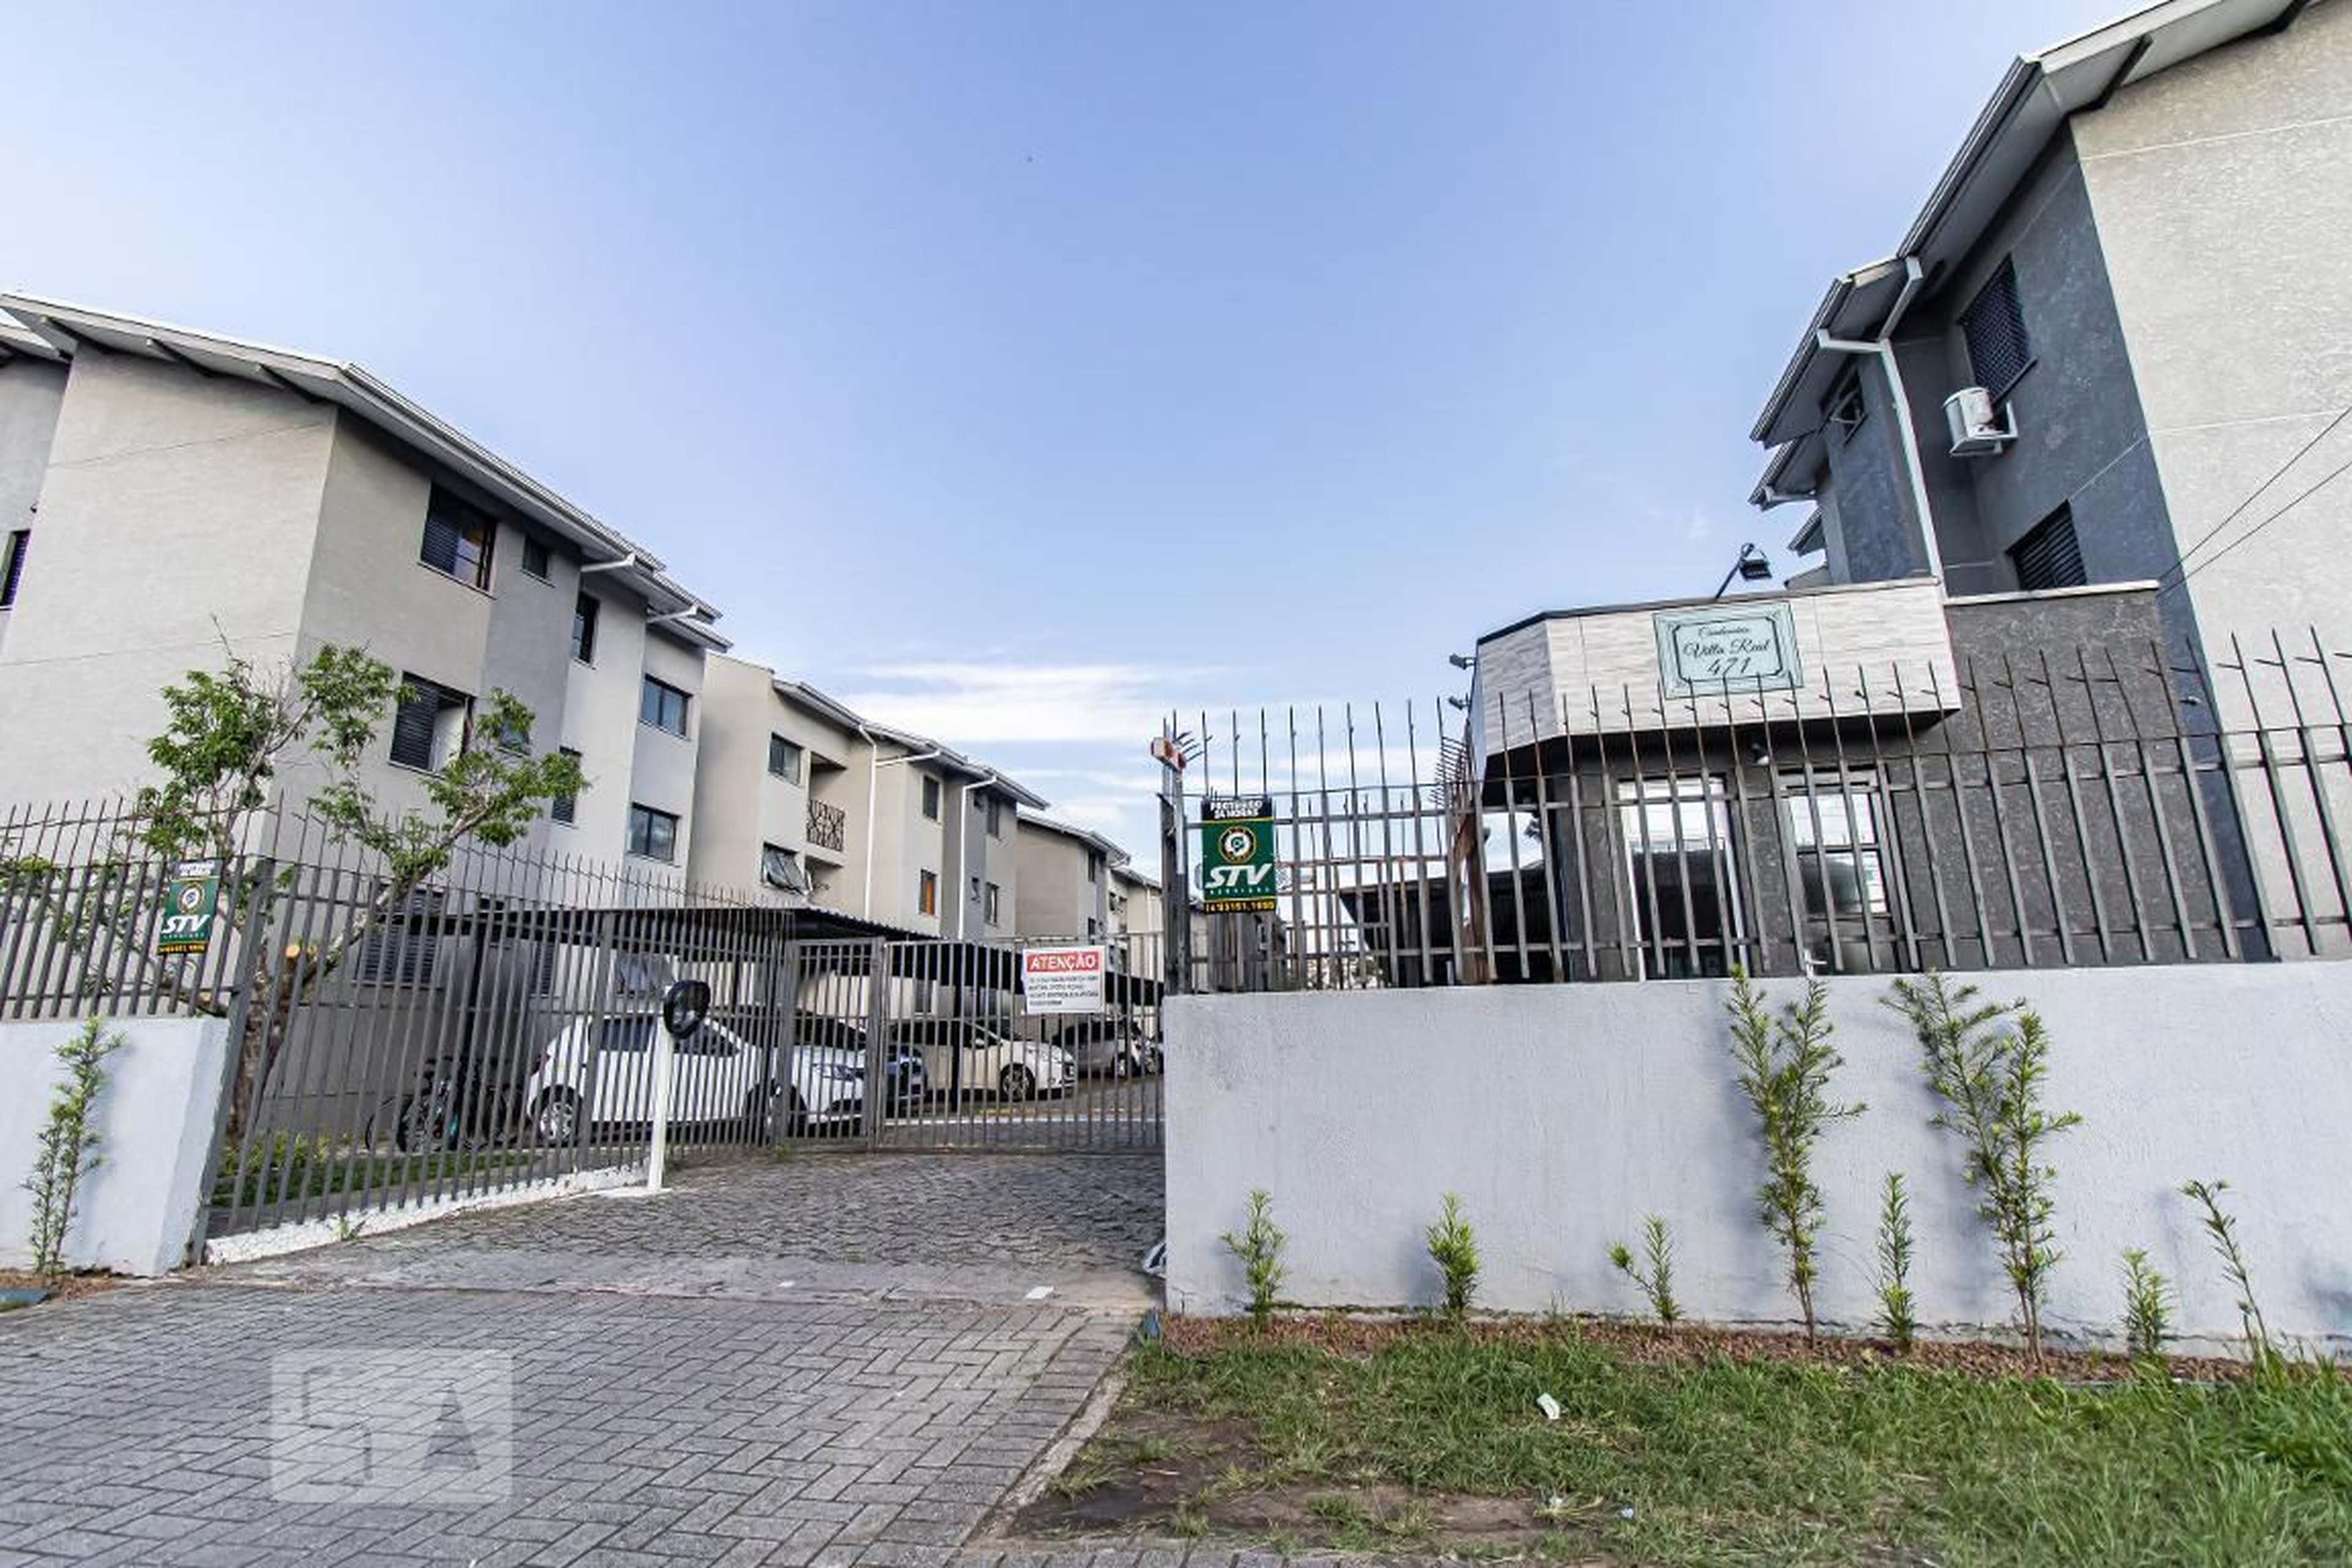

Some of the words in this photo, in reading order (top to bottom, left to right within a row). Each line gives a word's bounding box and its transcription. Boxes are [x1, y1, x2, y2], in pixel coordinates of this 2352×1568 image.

[1683, 642, 1725, 658] Villa
[1729, 638, 1771, 654] Real
[1706, 657, 1752, 676] 471
[1205, 862, 1273, 889] STV
[160, 914, 211, 934] STV
[1030, 954, 1096, 971] ATENÇÃO
